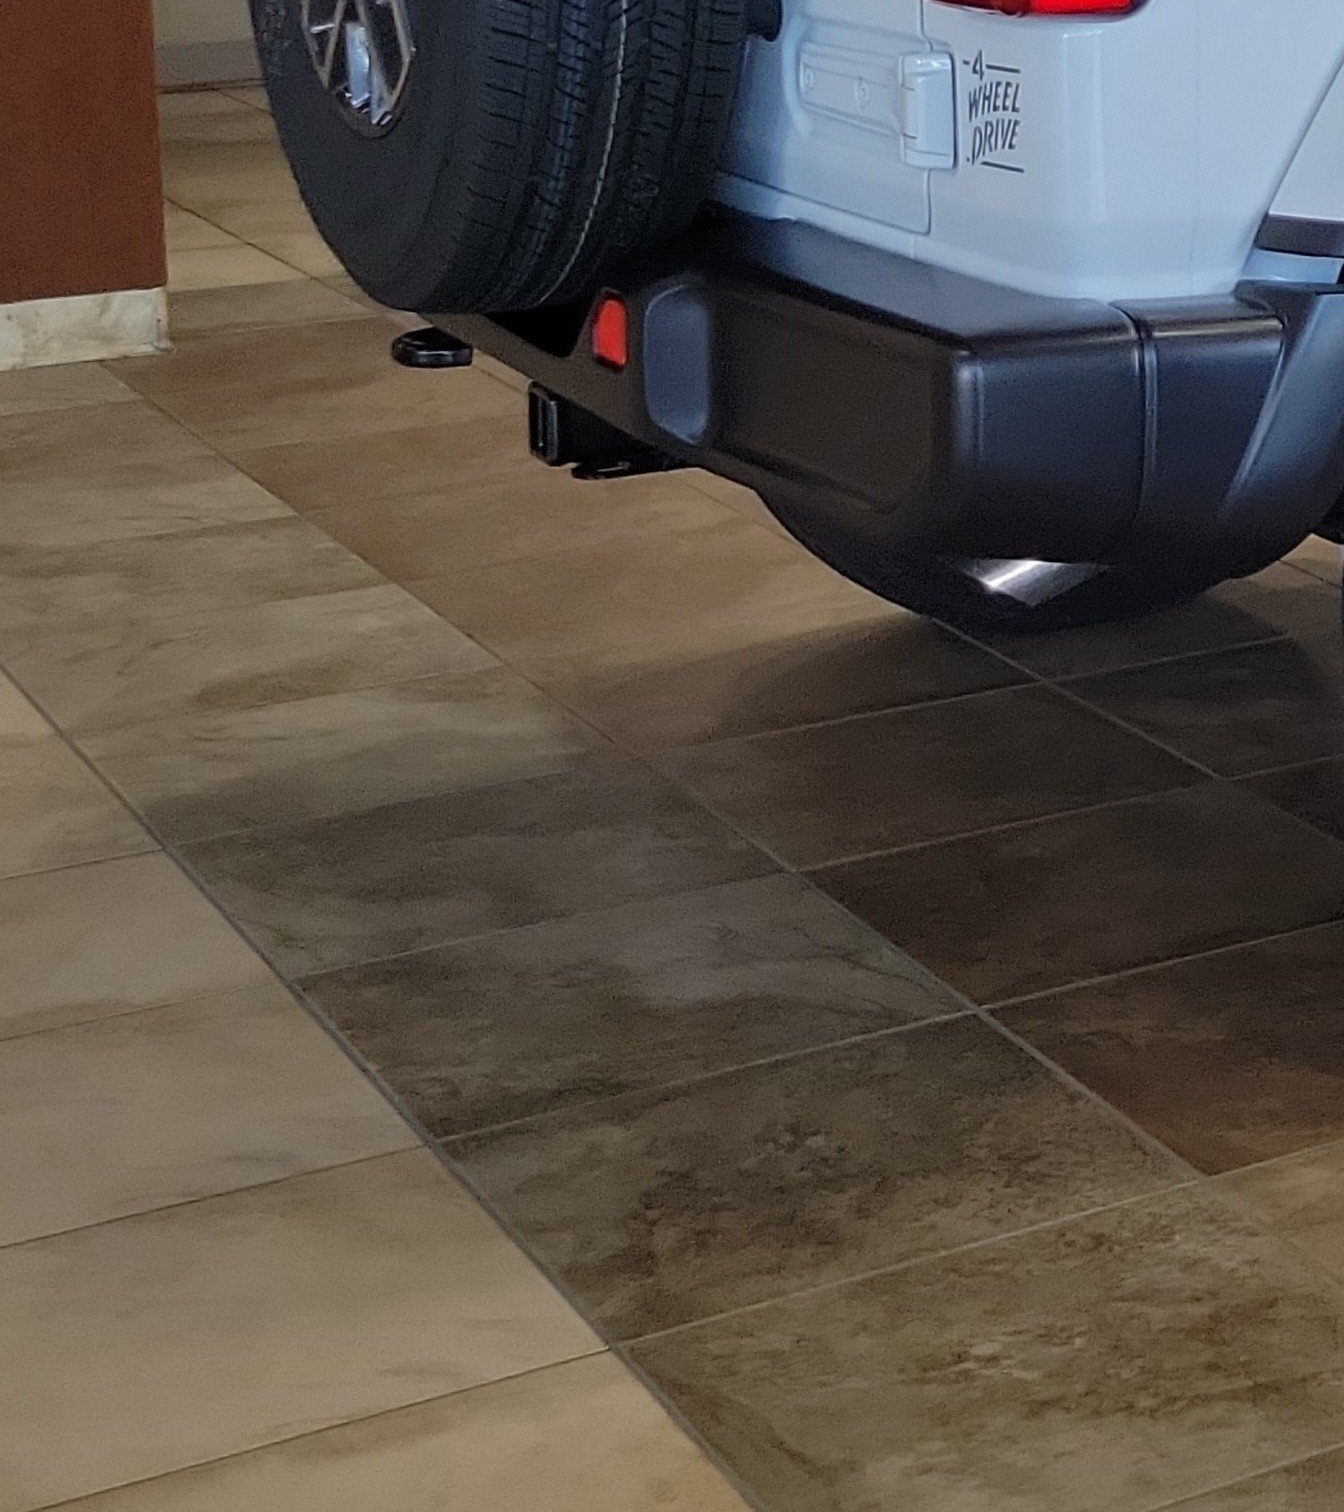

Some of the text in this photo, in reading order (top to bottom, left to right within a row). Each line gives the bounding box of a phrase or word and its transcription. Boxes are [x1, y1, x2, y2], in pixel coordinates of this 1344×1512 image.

[972, 49, 984, 81] 4
[968, 81, 1020, 122] WHEEL
[971, 118, 1020, 165] DRIVE
